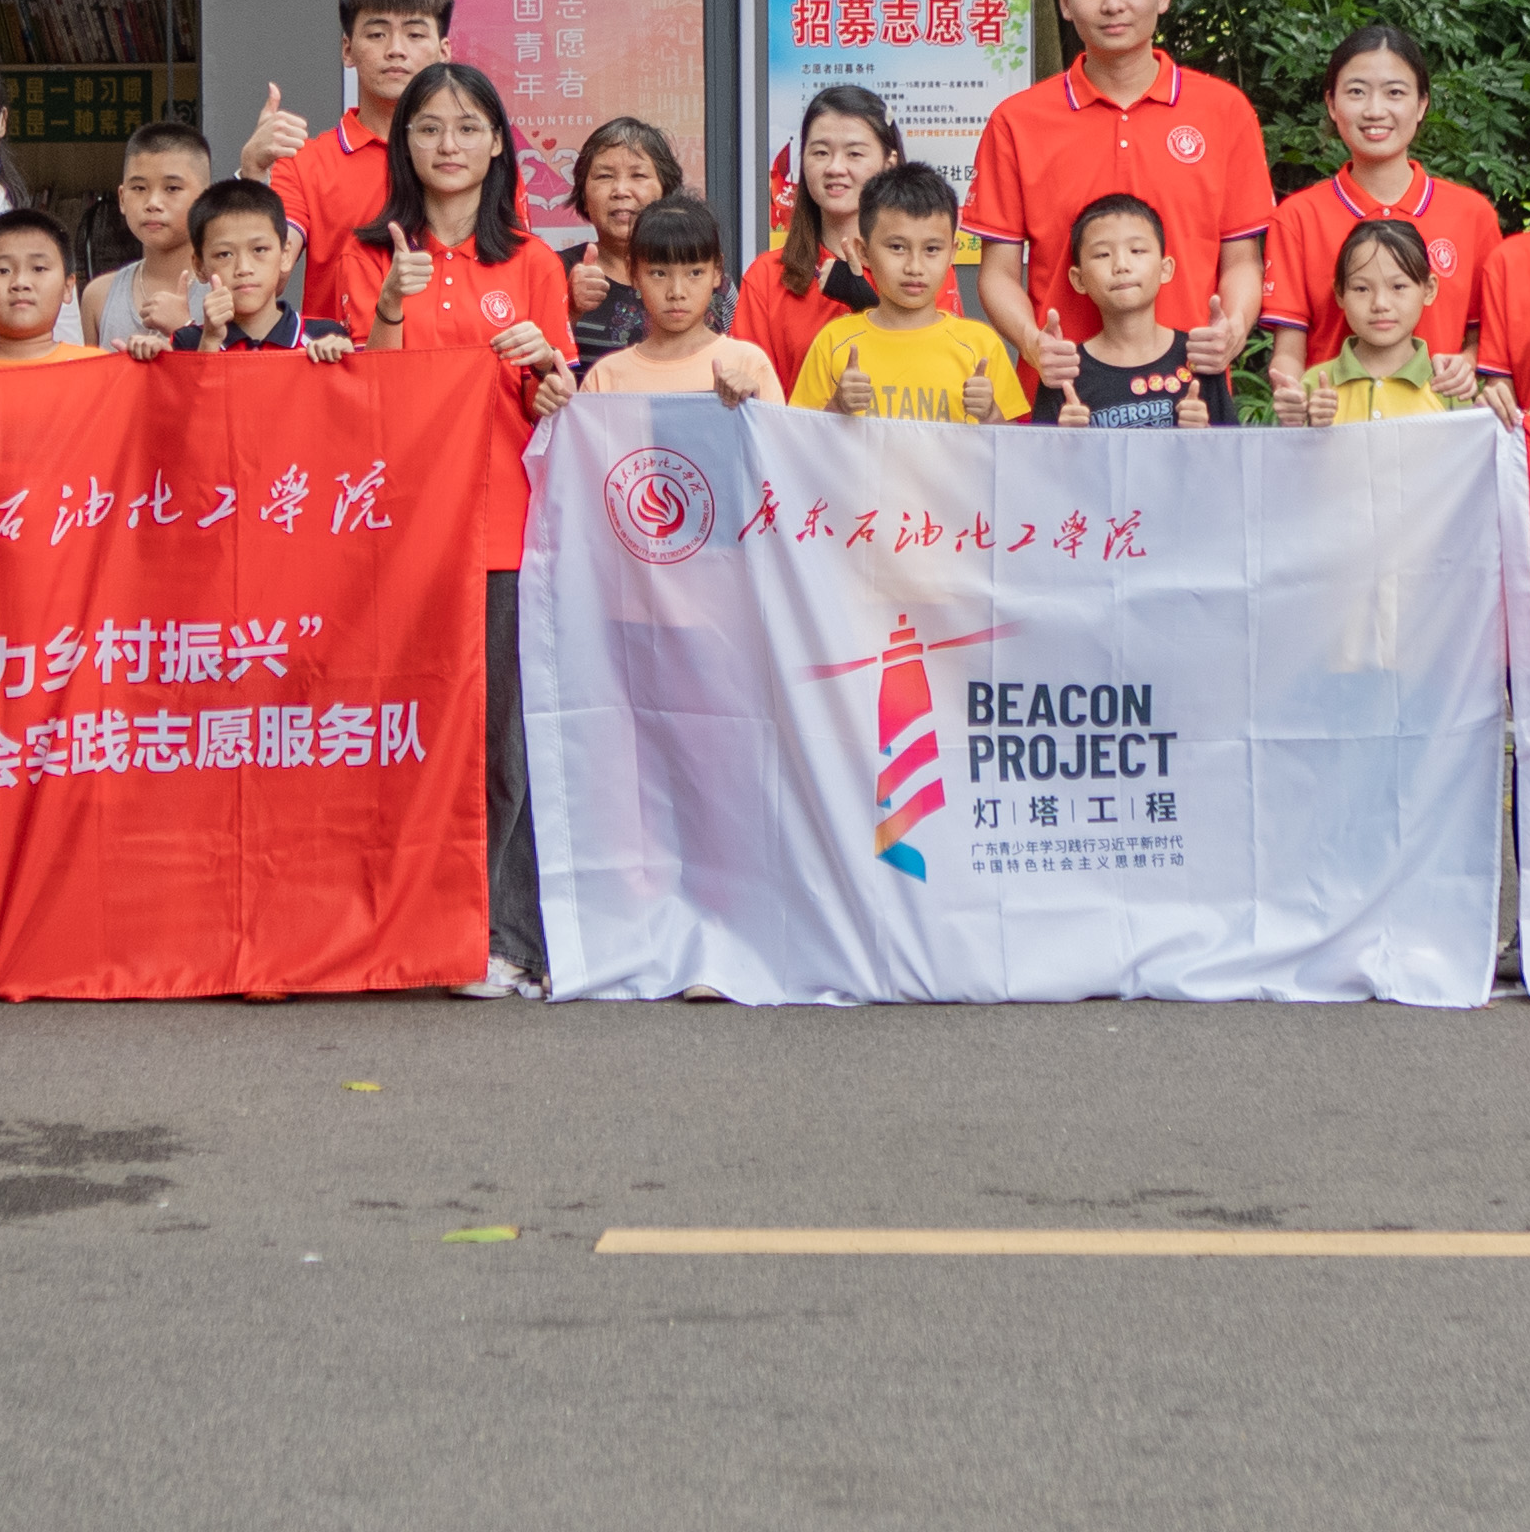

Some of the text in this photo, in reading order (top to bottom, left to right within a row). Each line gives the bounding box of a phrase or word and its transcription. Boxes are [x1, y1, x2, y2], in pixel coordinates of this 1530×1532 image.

[967, 681, 1152, 728] BEACON
[967, 732, 1178, 783] PROJECT
[971, 835, 1184, 857] 广东青少年学习践行习近平新时代
[972, 853, 1185, 875] 中国特色社会主义思想行动
